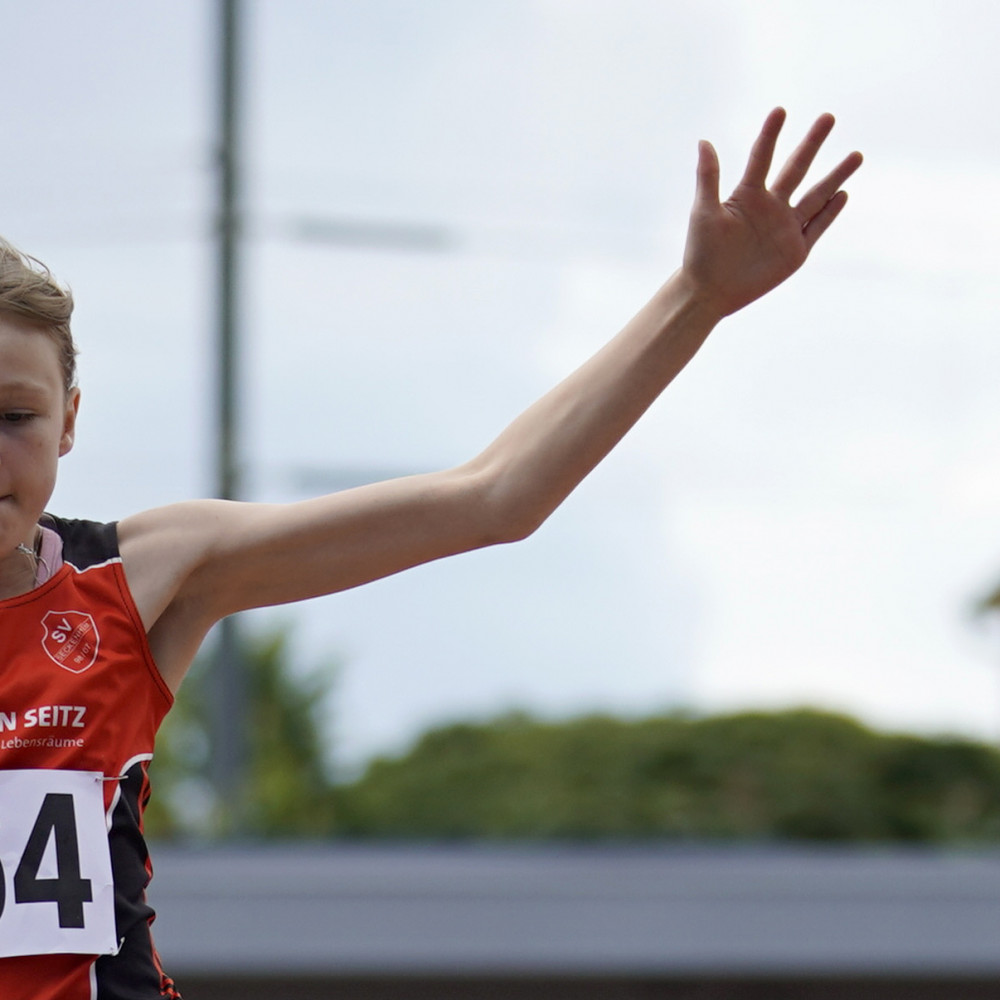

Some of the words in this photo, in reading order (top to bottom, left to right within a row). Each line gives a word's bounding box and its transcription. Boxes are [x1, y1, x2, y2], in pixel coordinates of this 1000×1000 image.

[51, 617, 72, 643] SV
[24, 705, 87, 729] SEITZ
[1, 735, 85, 750] Lebensräume
